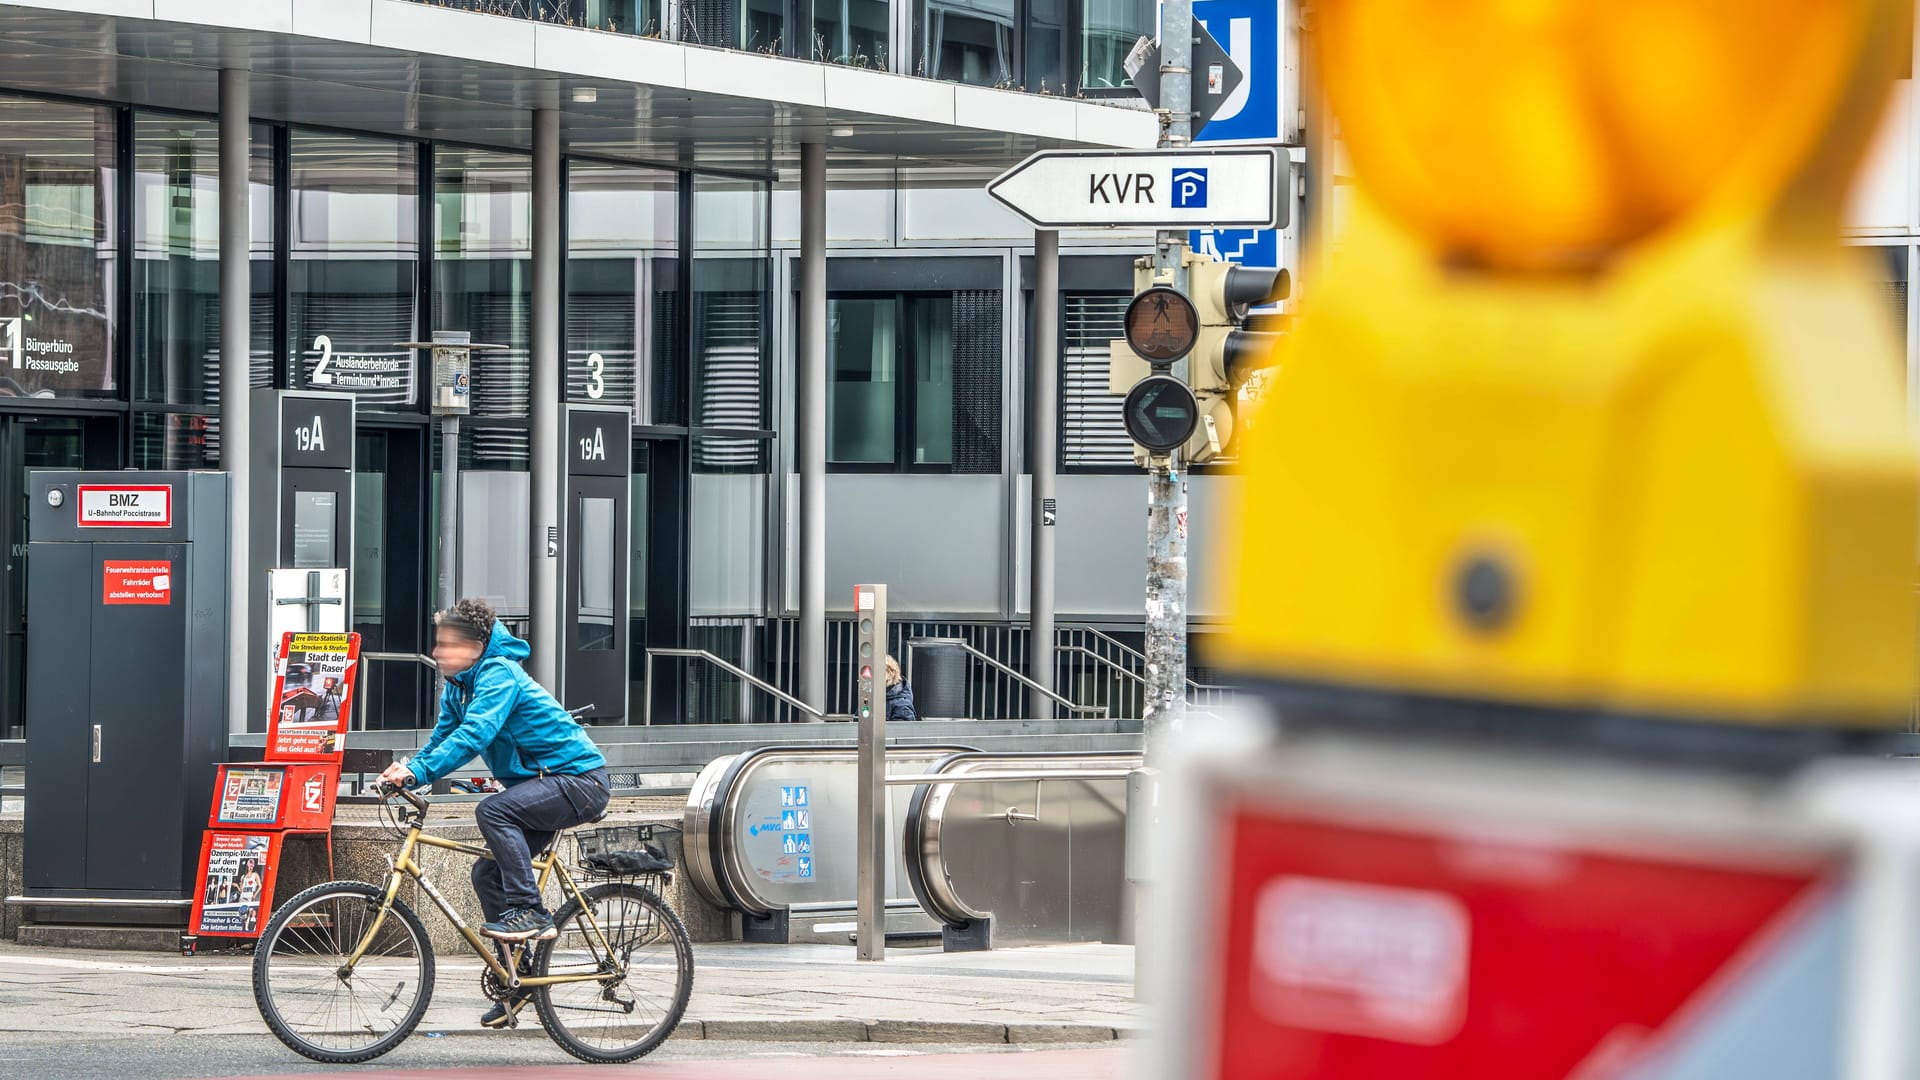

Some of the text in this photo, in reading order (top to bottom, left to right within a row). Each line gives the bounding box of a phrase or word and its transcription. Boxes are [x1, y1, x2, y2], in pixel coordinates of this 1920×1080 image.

[1089, 173, 1197, 206] KVR P
[6, 317, 22, 369] 1
[25, 337, 73, 355] Bürgerbüro
[312, 334, 333, 385] 2
[335, 355, 399, 371] Ausländerbehörde
[25, 355, 79, 375] Passausgabe
[586, 352, 605, 399] 3
[294, 415, 326, 452] 19A
[579, 427, 606, 461] 19A
[109, 493, 140, 507] BMZ
[88, 509, 162, 518] U-Bahnhof Poccistrasse
[105, 566, 169, 574] Feuerwehranlaufstelle
[122, 578, 152, 586] Fahrräder
[109, 591, 165, 599] abstellen verboten!
[307, 652, 346, 663] Stadt der
[321, 664, 345, 673] Raser
[277, 736, 292, 744] Jetzt
[292, 737, 307, 745] geht
[276, 745, 289, 753] das
[289, 745, 303, 753] Geld
[759, 823, 782, 832] MVG
[211, 849, 259, 859] Ozempic-Wahn
[209, 858, 221, 866] auf
[208, 866, 237, 876] Laufsteg
